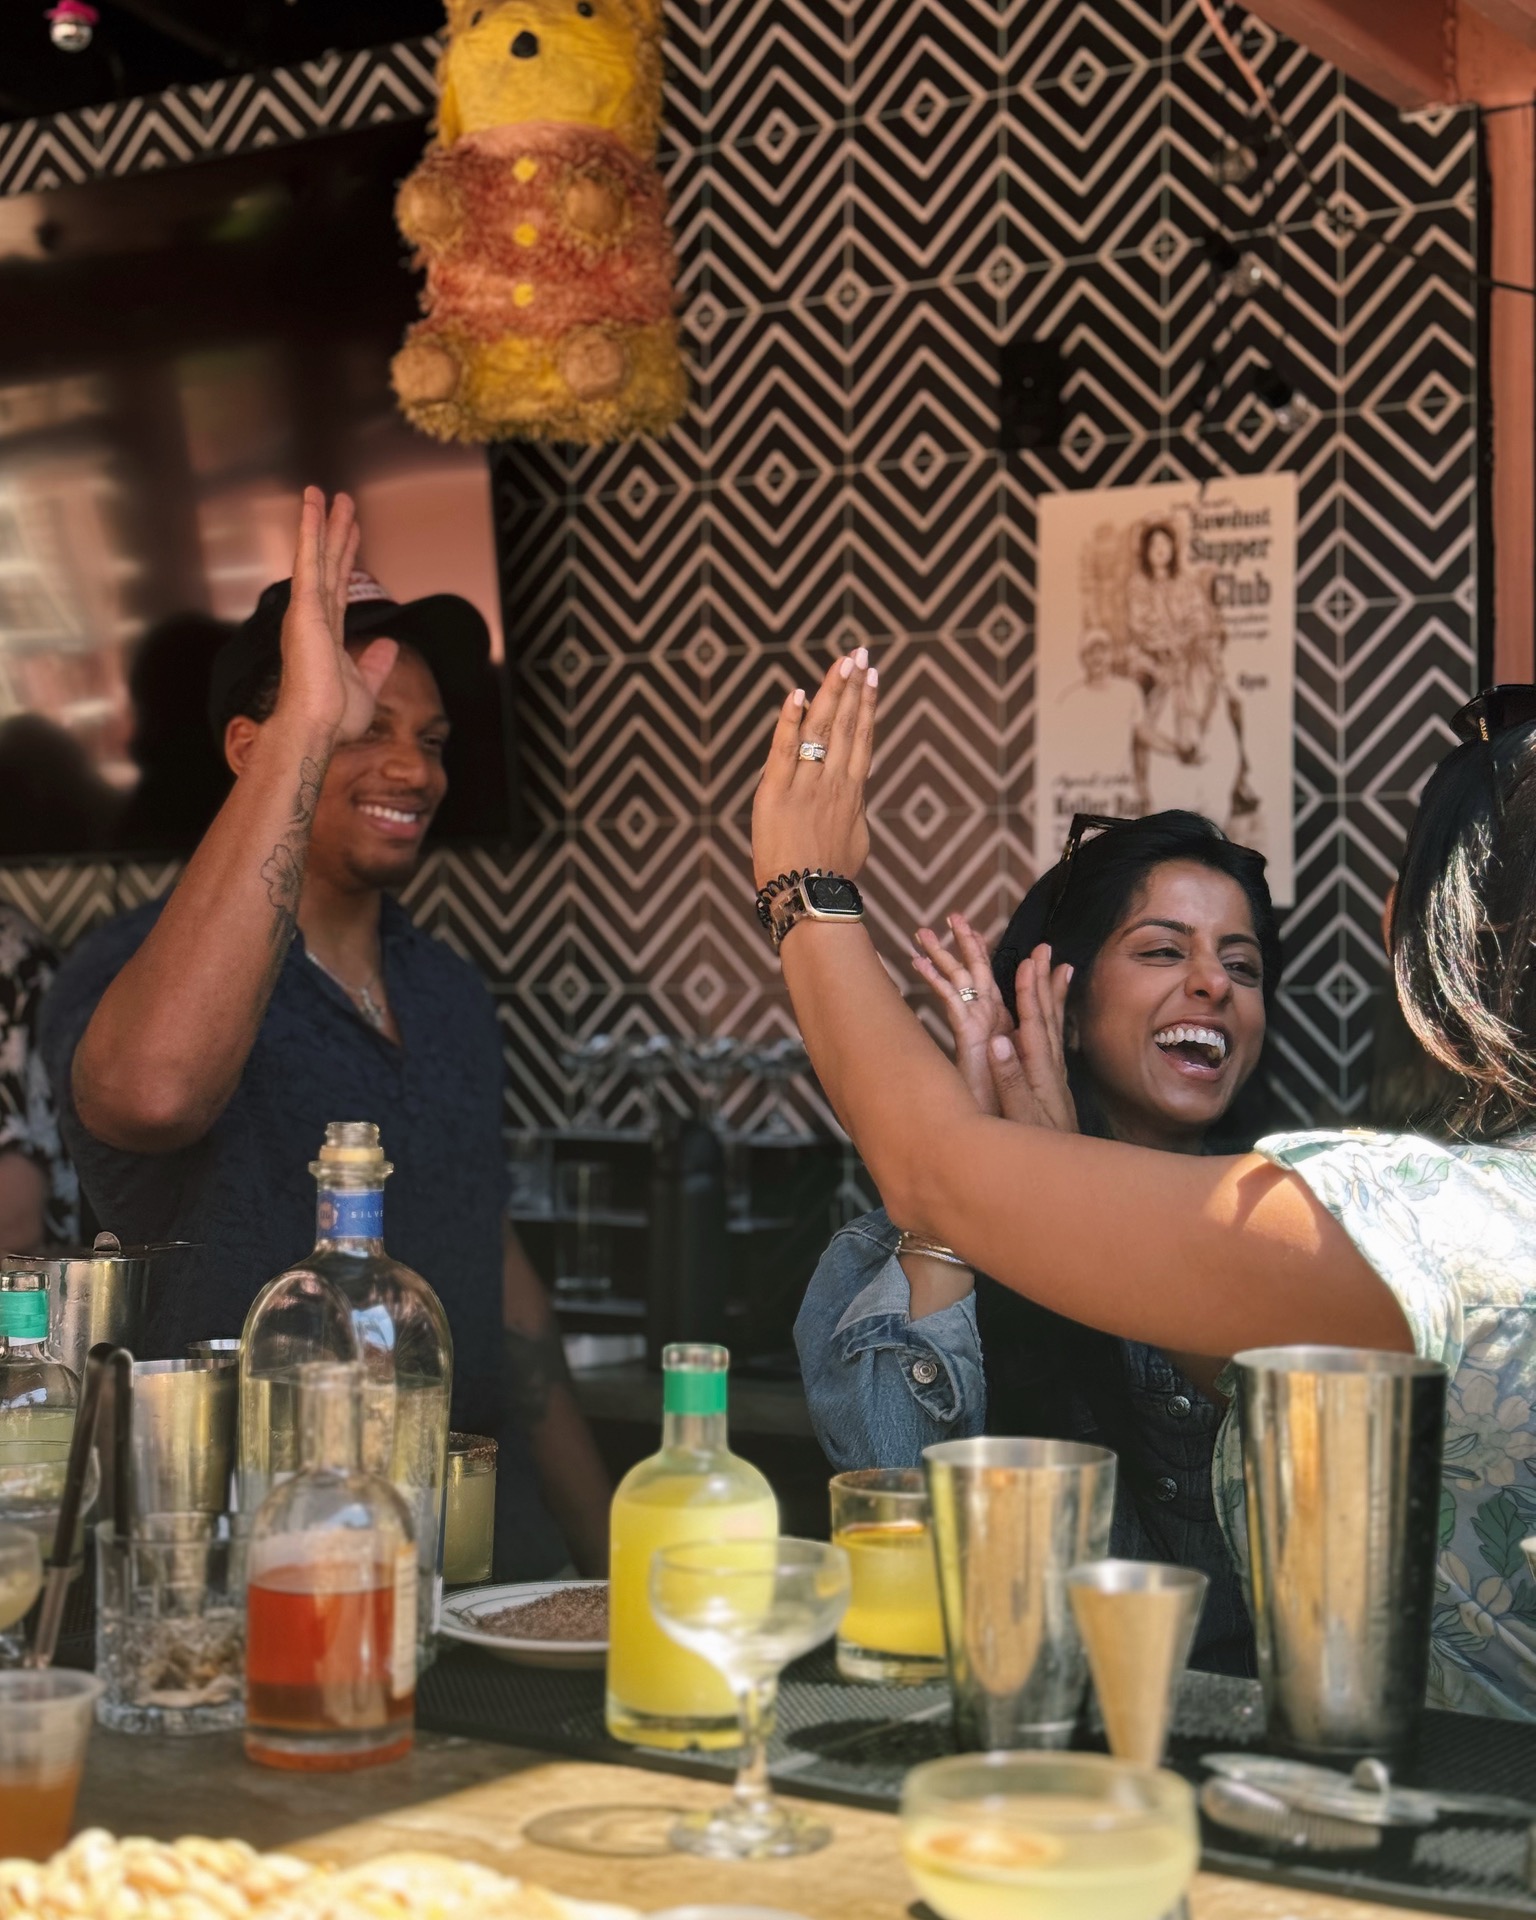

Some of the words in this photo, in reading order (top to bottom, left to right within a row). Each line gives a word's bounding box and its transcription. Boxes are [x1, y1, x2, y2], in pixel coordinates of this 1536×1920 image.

[1189, 538, 1269, 567] Supper
[1210, 571, 1270, 607] Club
[1479, 717, 1489, 741] QUAY
